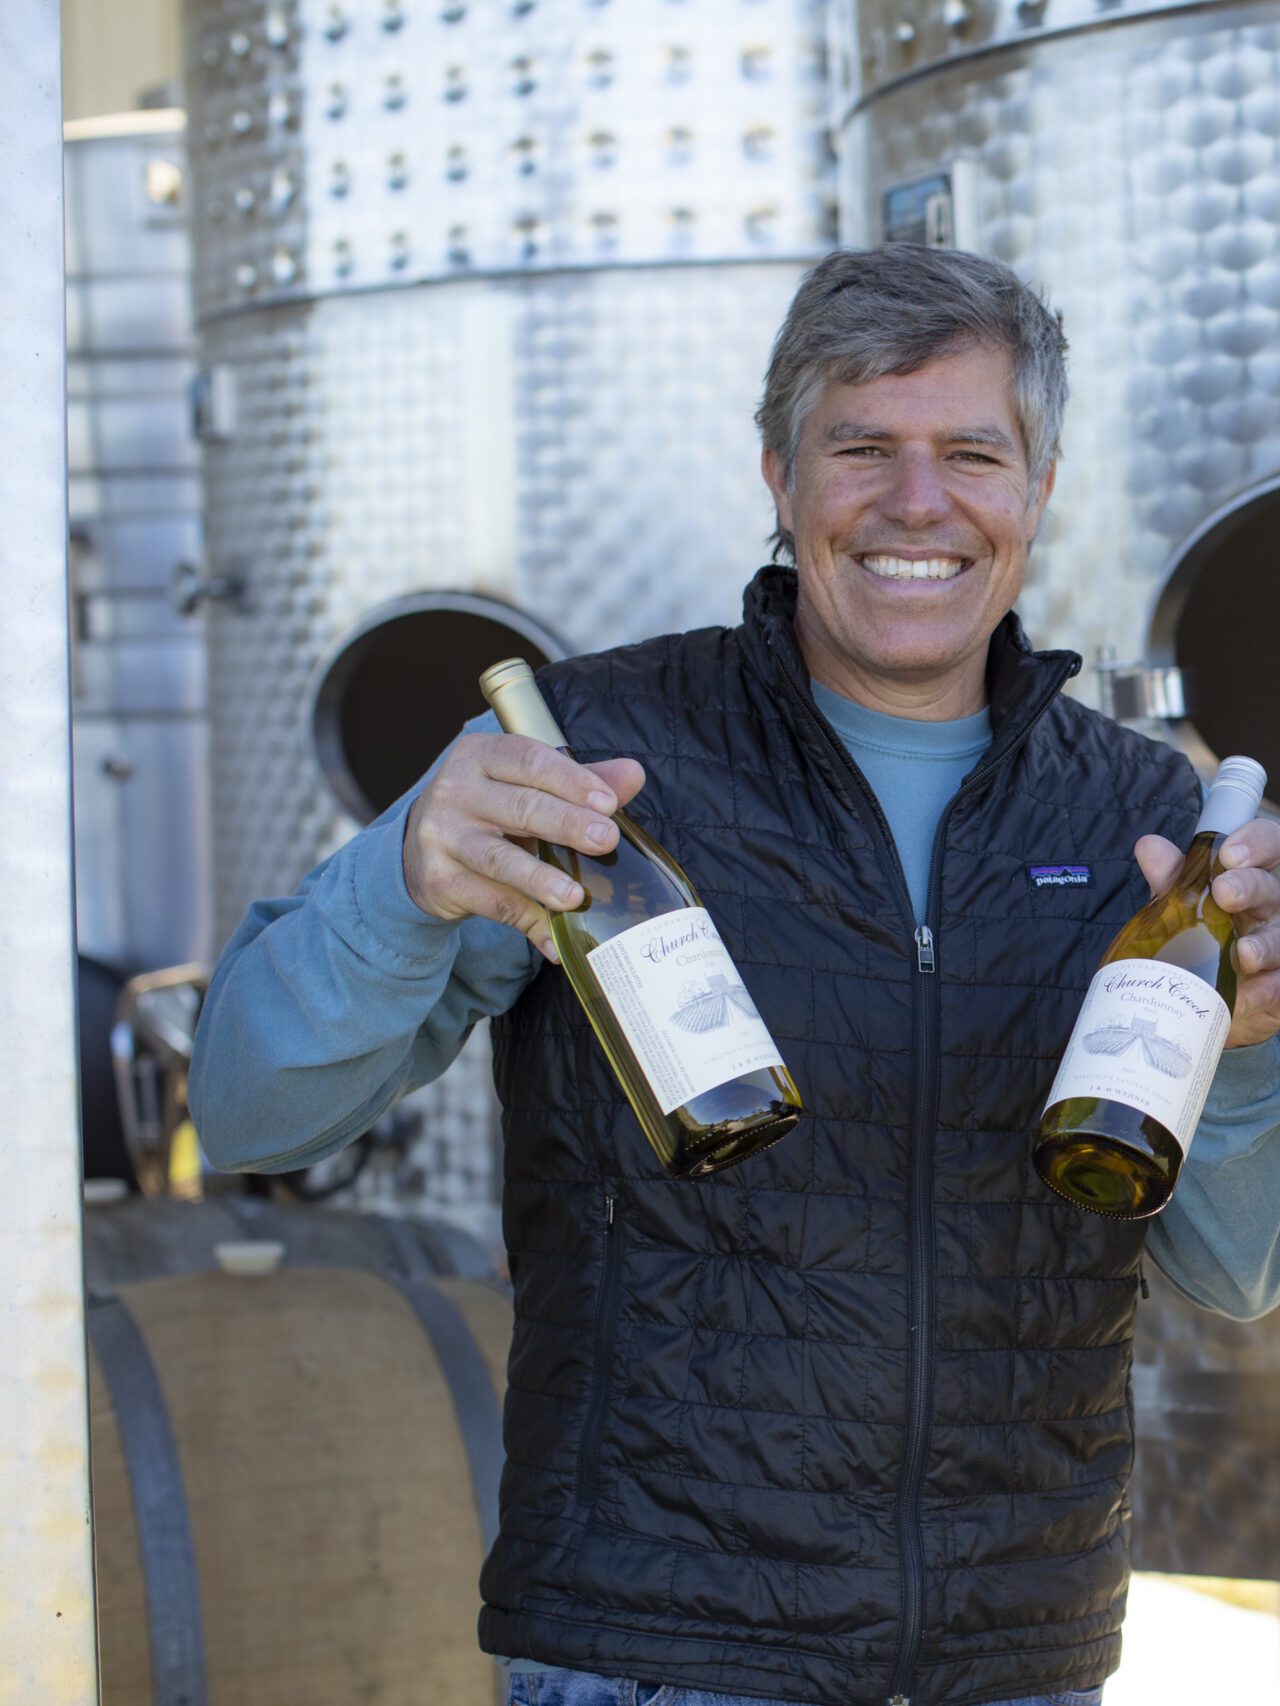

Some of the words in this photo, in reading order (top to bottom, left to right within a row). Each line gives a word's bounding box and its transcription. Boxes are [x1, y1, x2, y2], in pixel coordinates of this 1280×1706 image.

[1035, 874, 1088, 887] patagonia
[640, 922, 700, 963] Church
[1104, 972, 1165, 993] Church
[1168, 976, 1210, 1020] Creek
[1120, 991, 1184, 1019] Chardonnay
